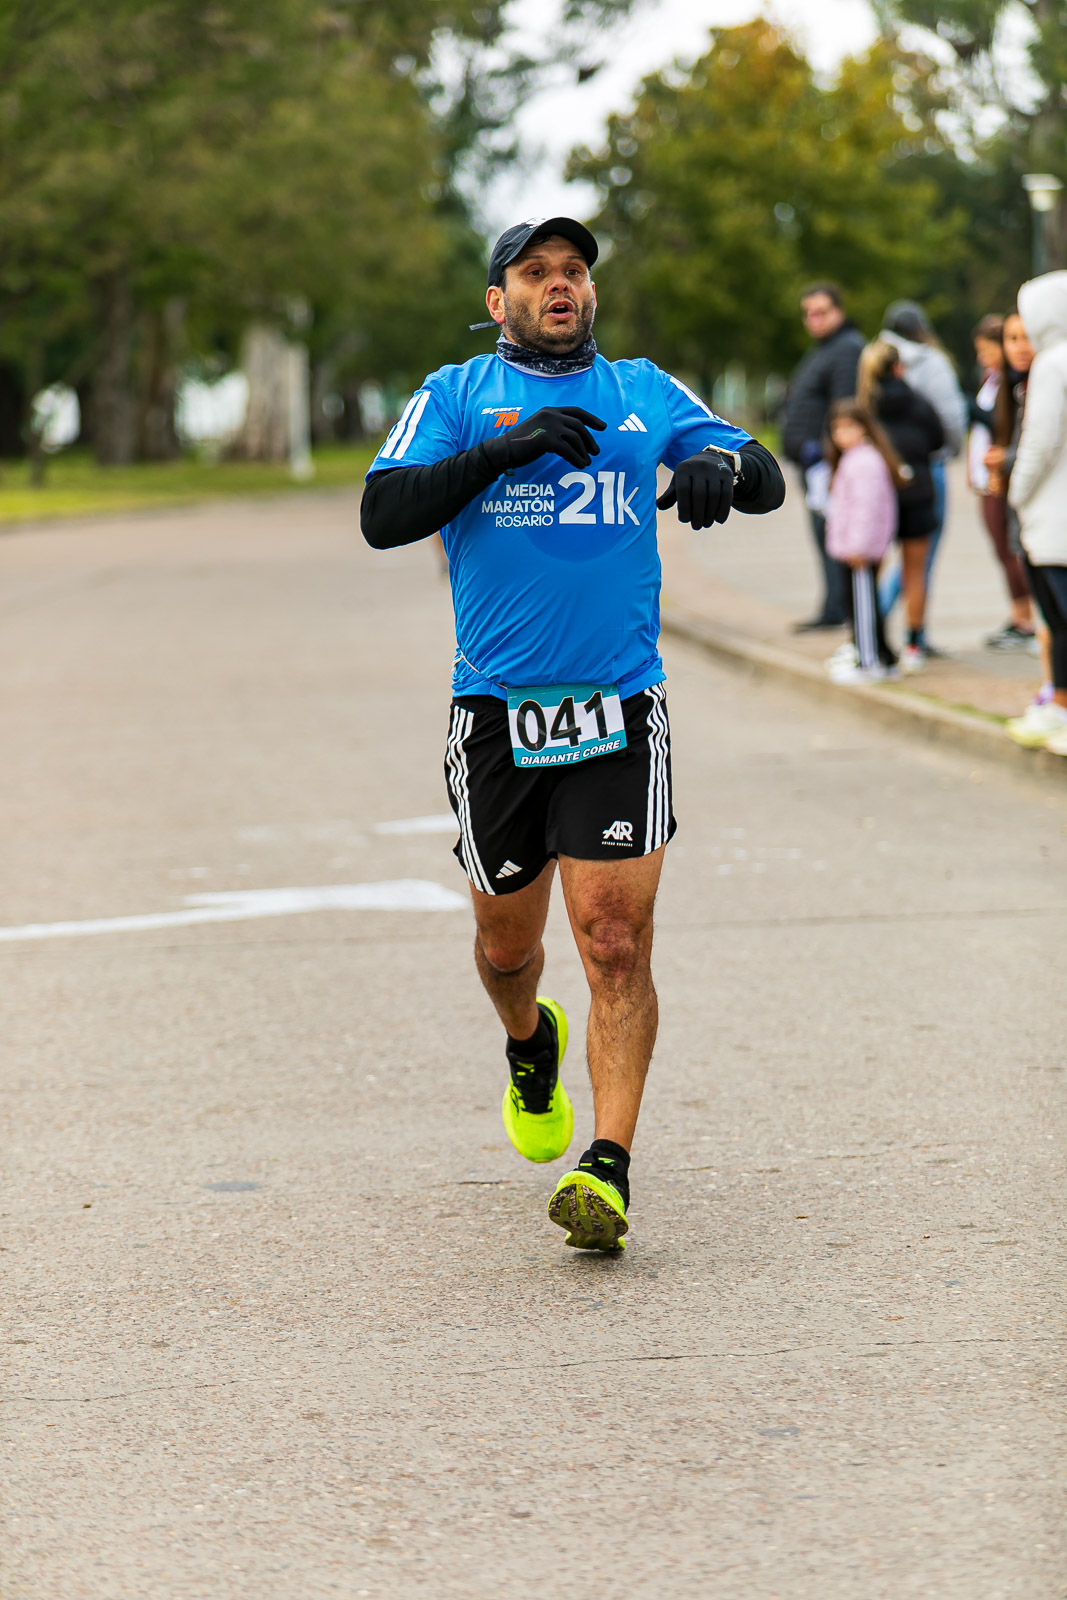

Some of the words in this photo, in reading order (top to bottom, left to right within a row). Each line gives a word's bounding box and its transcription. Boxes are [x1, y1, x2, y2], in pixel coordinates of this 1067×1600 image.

[494, 412, 519, 428] 78
[506, 484, 555, 497] MEDIA
[481, 497, 555, 513] MARATÓN
[495, 515, 553, 527] ROSARIO
[517, 691, 609, 752] 041
[520, 751, 580, 765] DIAMANTE
[582, 739, 621, 758] CORRE
[602, 820, 633, 841] AR
